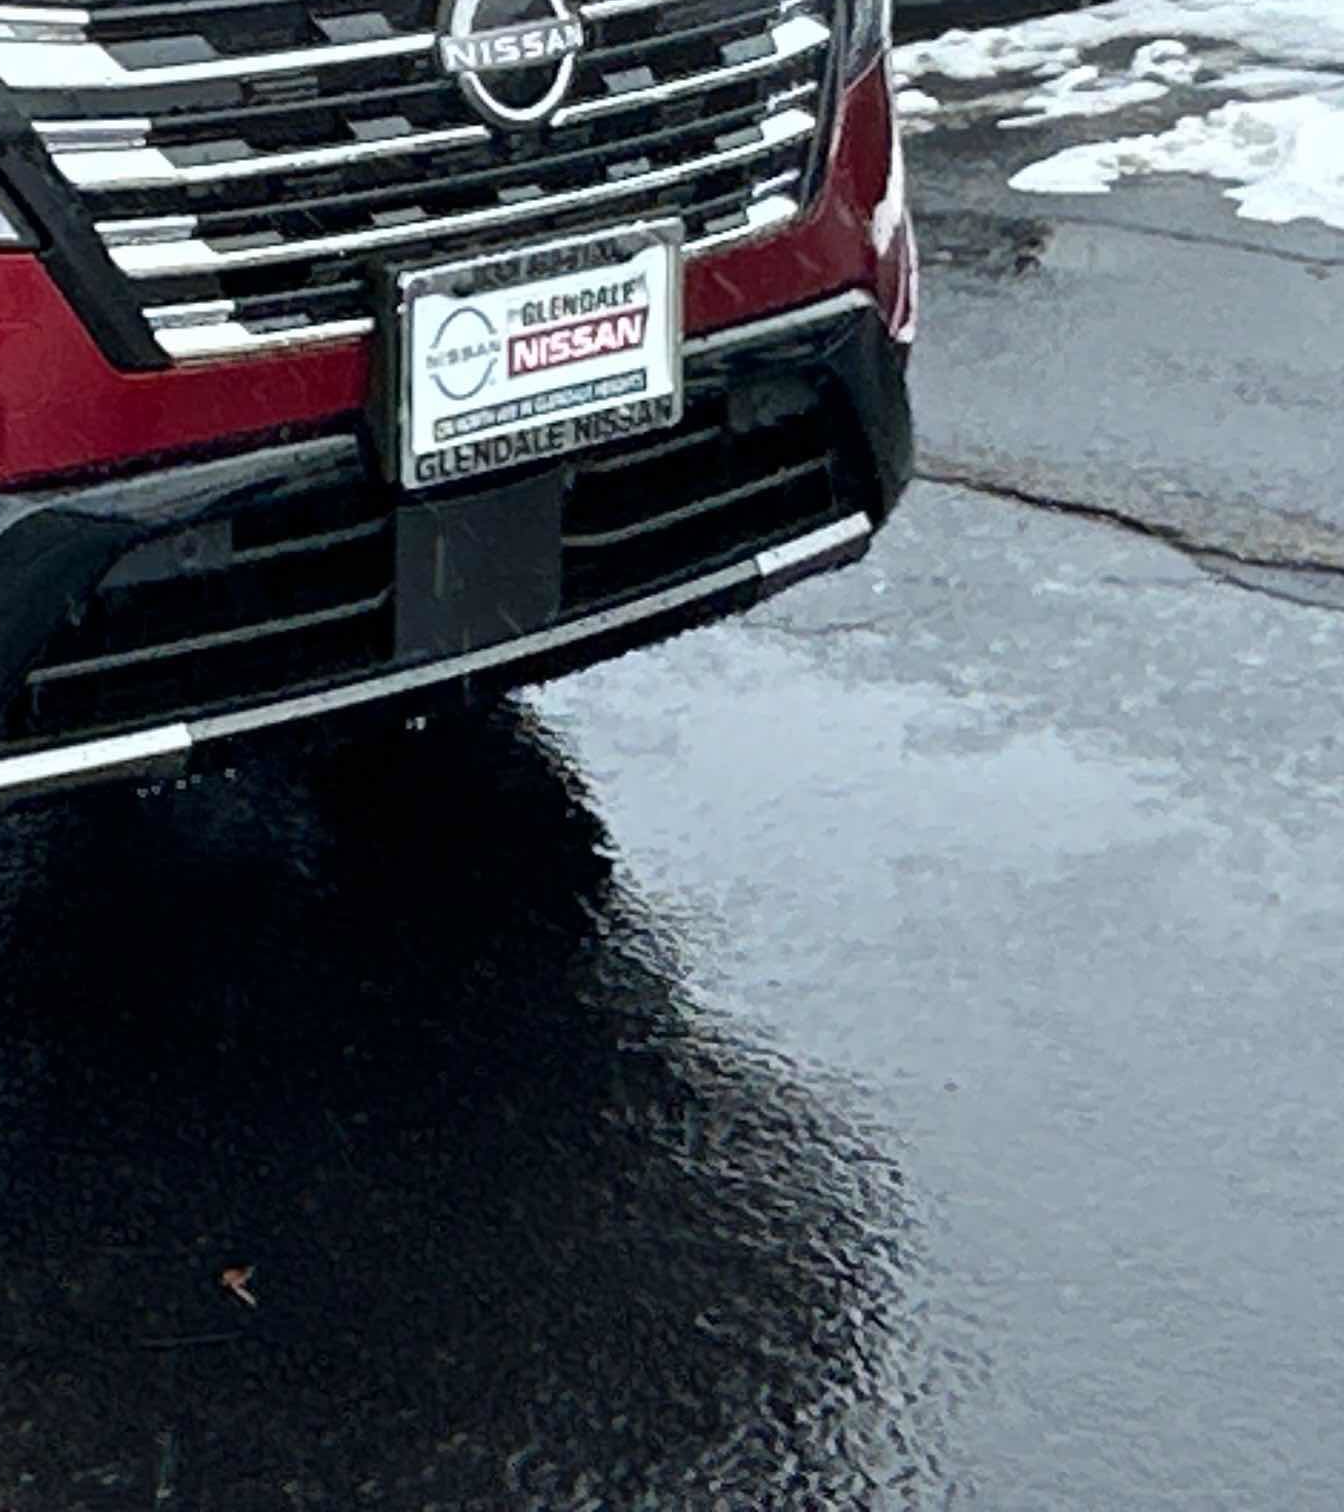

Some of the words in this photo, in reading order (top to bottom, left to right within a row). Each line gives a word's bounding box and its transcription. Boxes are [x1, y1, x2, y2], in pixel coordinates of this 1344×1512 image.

[443, 22, 584, 72] NISSAN
[521, 279, 637, 327] GLENDALE
[513, 313, 643, 372] NISSAN
[414, 424, 564, 481] GLENDALE
[573, 394, 674, 441] NISSAN
